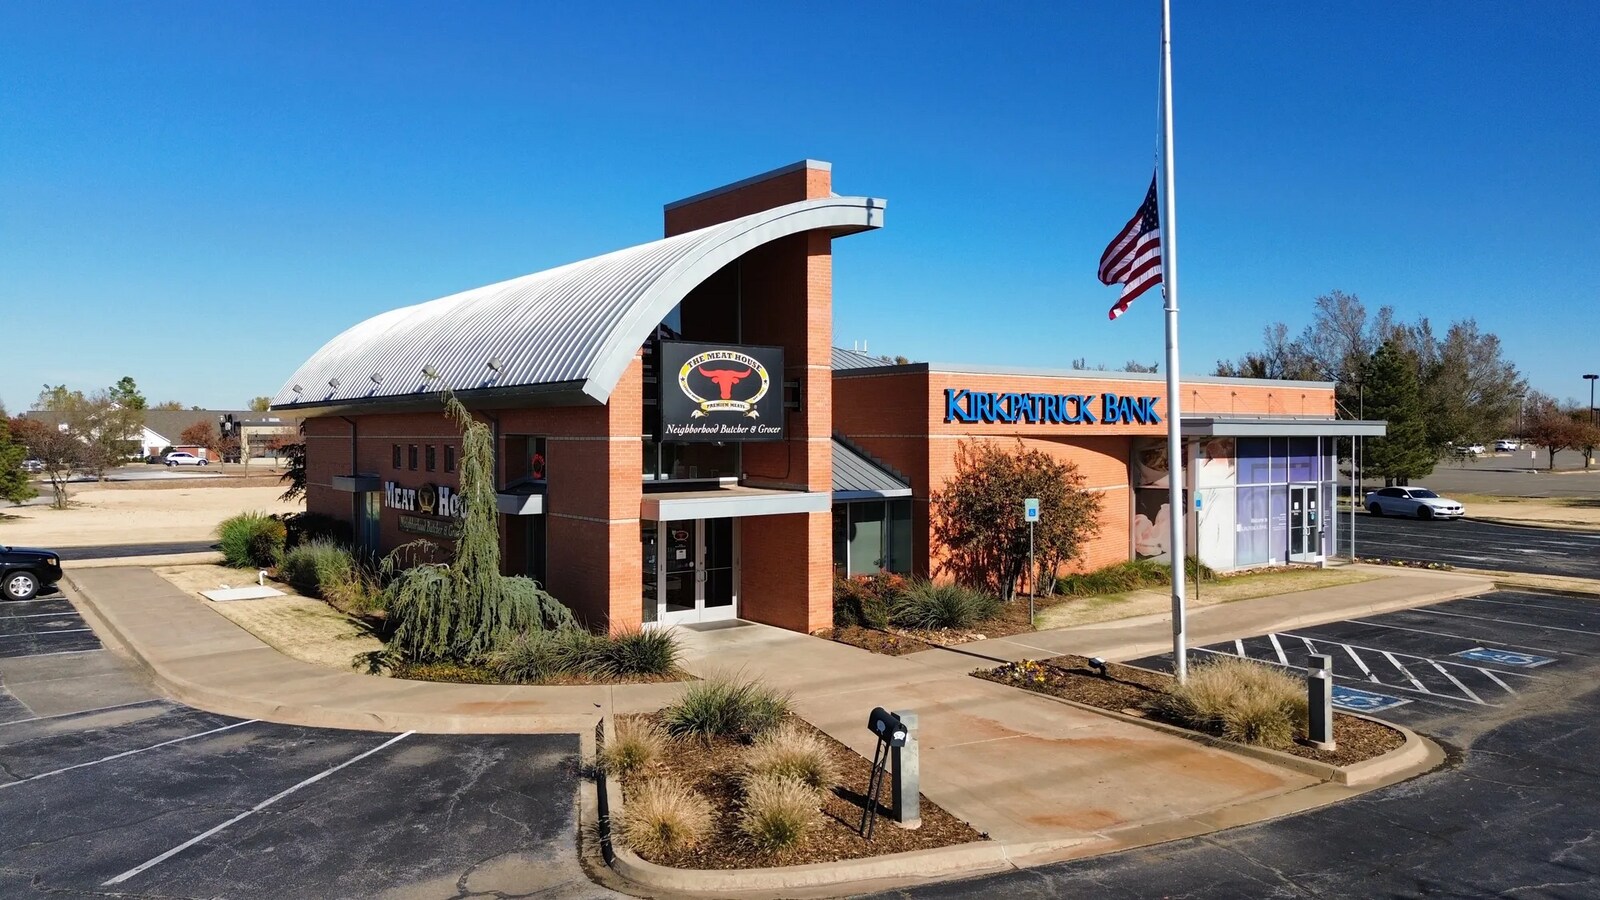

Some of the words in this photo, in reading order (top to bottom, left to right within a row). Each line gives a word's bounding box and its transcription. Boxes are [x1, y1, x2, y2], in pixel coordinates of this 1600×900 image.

[687, 356, 706, 369] THE
[707, 352, 733, 360] MEAT
[734, 353, 762, 371] HOUSE
[946, 388, 1098, 423] KIRKPATRICK
[1102, 393, 1163, 423] BANK
[665, 423, 719, 436] Neighborhood
[720, 424, 749, 434] Butcher
[750, 425, 757, 434] &
[758, 424, 781, 434] Grocer
[384, 481, 416, 511] MEAT
[438, 486, 468, 519] HOU
